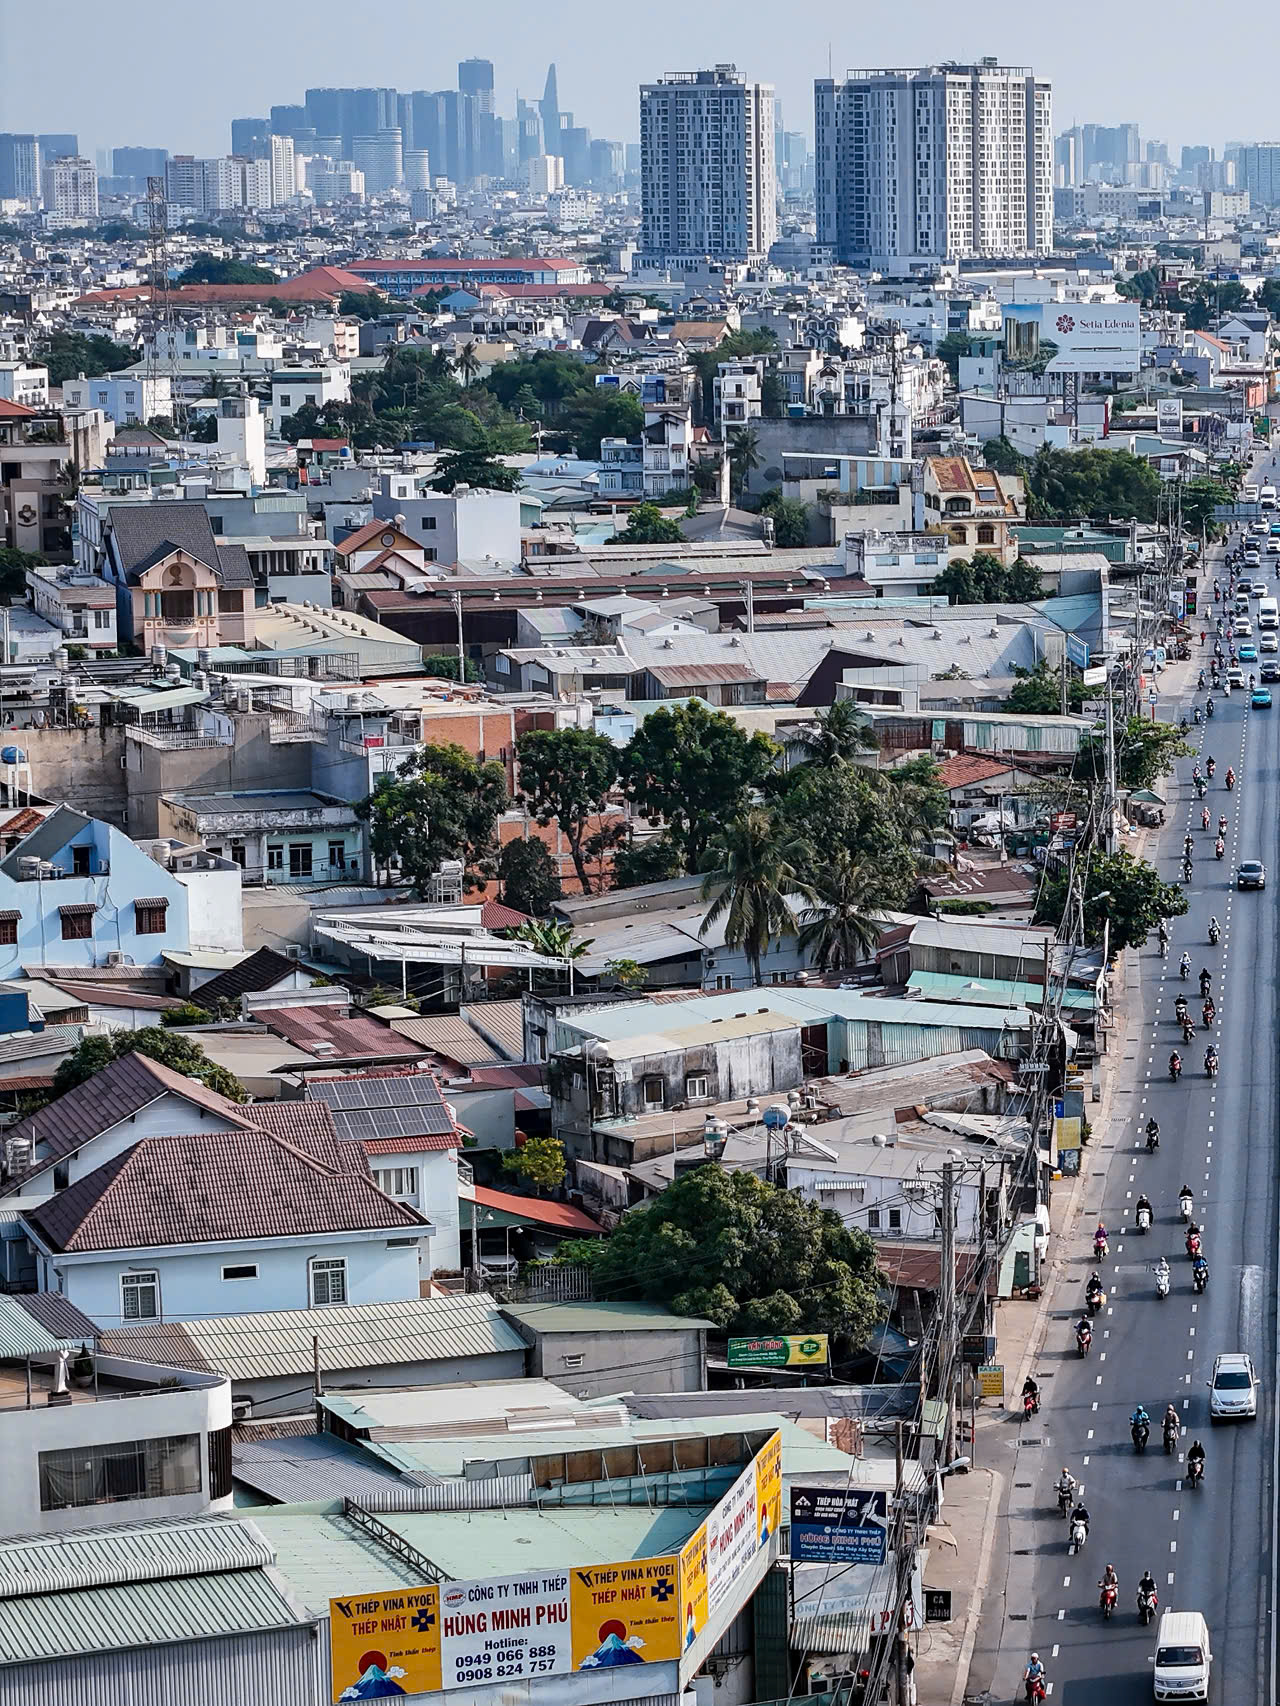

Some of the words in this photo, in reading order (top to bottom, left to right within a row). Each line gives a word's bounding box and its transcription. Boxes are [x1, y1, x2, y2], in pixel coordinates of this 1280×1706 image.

[1080, 320, 1102, 328] Setia
[1104, 320, 1135, 328] Edenia
[817, 1496, 831, 1506] THÉP
[831, 1496, 843, 1506] HÒA
[845, 1498, 859, 1507] PHÁT
[720, 1523, 733, 1556] HÙNG
[734, 1506, 745, 1537] MINH
[800, 1532, 830, 1544] HÙNG
[832, 1535, 859, 1545] MINH
[861, 1535, 881, 1546] PHÚ
[594, 1569, 618, 1585] THÉP
[621, 1568, 643, 1581] VINA
[646, 1564, 674, 1578] KYOEI
[468, 1585, 494, 1602] CÔNG
[497, 1584, 509, 1598] TY
[513, 1581, 538, 1596] TNHH
[542, 1574, 567, 1592] THÉP
[592, 1588, 617, 1605] THÉP
[621, 1585, 646, 1601] NHẬT
[355, 1599, 379, 1615] THÉP
[383, 1598, 404, 1611] VINA
[407, 1593, 435, 1608] KYOEI
[352, 1619, 378, 1636] THÉP
[381, 1615, 407, 1632] NHẬT
[444, 1612, 487, 1637] HÙNG
[491, 1607, 531, 1631] MINH
[536, 1597, 568, 1625] PHÚ
[485, 1638, 528, 1650] Hotline:
[455, 1653, 491, 1668] 0949
[497, 1649, 524, 1663] 066
[529, 1645, 556, 1659] 888
[456, 1668, 492, 1682] 0908
[496, 1663, 523, 1677] 824
[529, 1659, 556, 1673] 757
